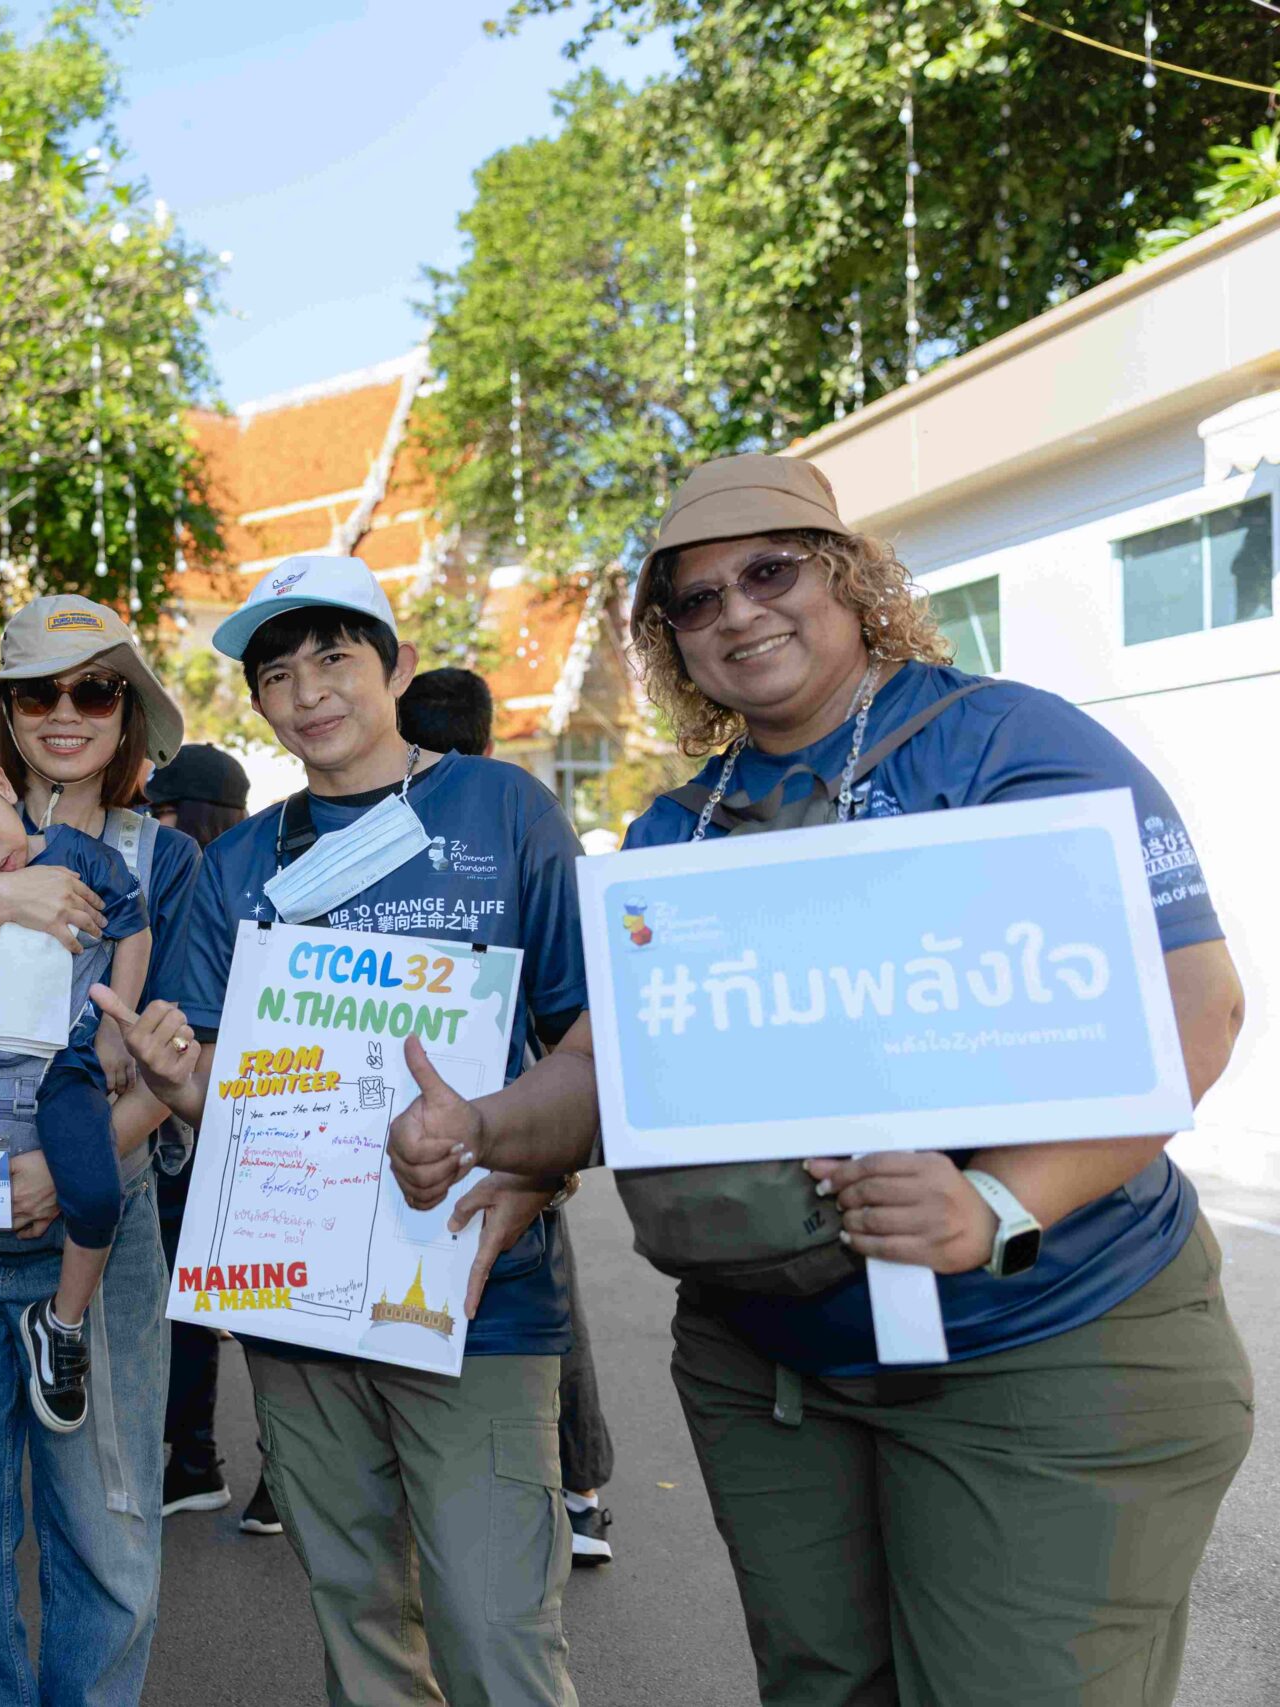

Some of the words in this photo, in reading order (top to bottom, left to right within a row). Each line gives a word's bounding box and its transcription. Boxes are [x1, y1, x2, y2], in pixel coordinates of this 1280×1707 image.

[450, 840, 468, 852] Zy
[450, 852, 495, 862] Movement
[453, 862, 498, 872] Foundation
[374, 898, 445, 917] CHANGE
[454, 900, 467, 913] A
[470, 900, 505, 914] LIFE
[377, 913, 479, 932] 攀向生命之峰
[288, 941, 455, 995] CTCAL32
[637, 921, 1111, 1038] #ทีมพลังใจ
[257, 986, 469, 1046] N.THANONT
[238, 1045, 325, 1076] FROM
[218, 1072, 341, 1100] VOLUNTEER
[292, 1104, 308, 1114] the
[312, 1103, 331, 1112] best
[178, 1261, 308, 1292] MAKING
[194, 1290, 211, 1312] A
[219, 1287, 294, 1311] MARK
